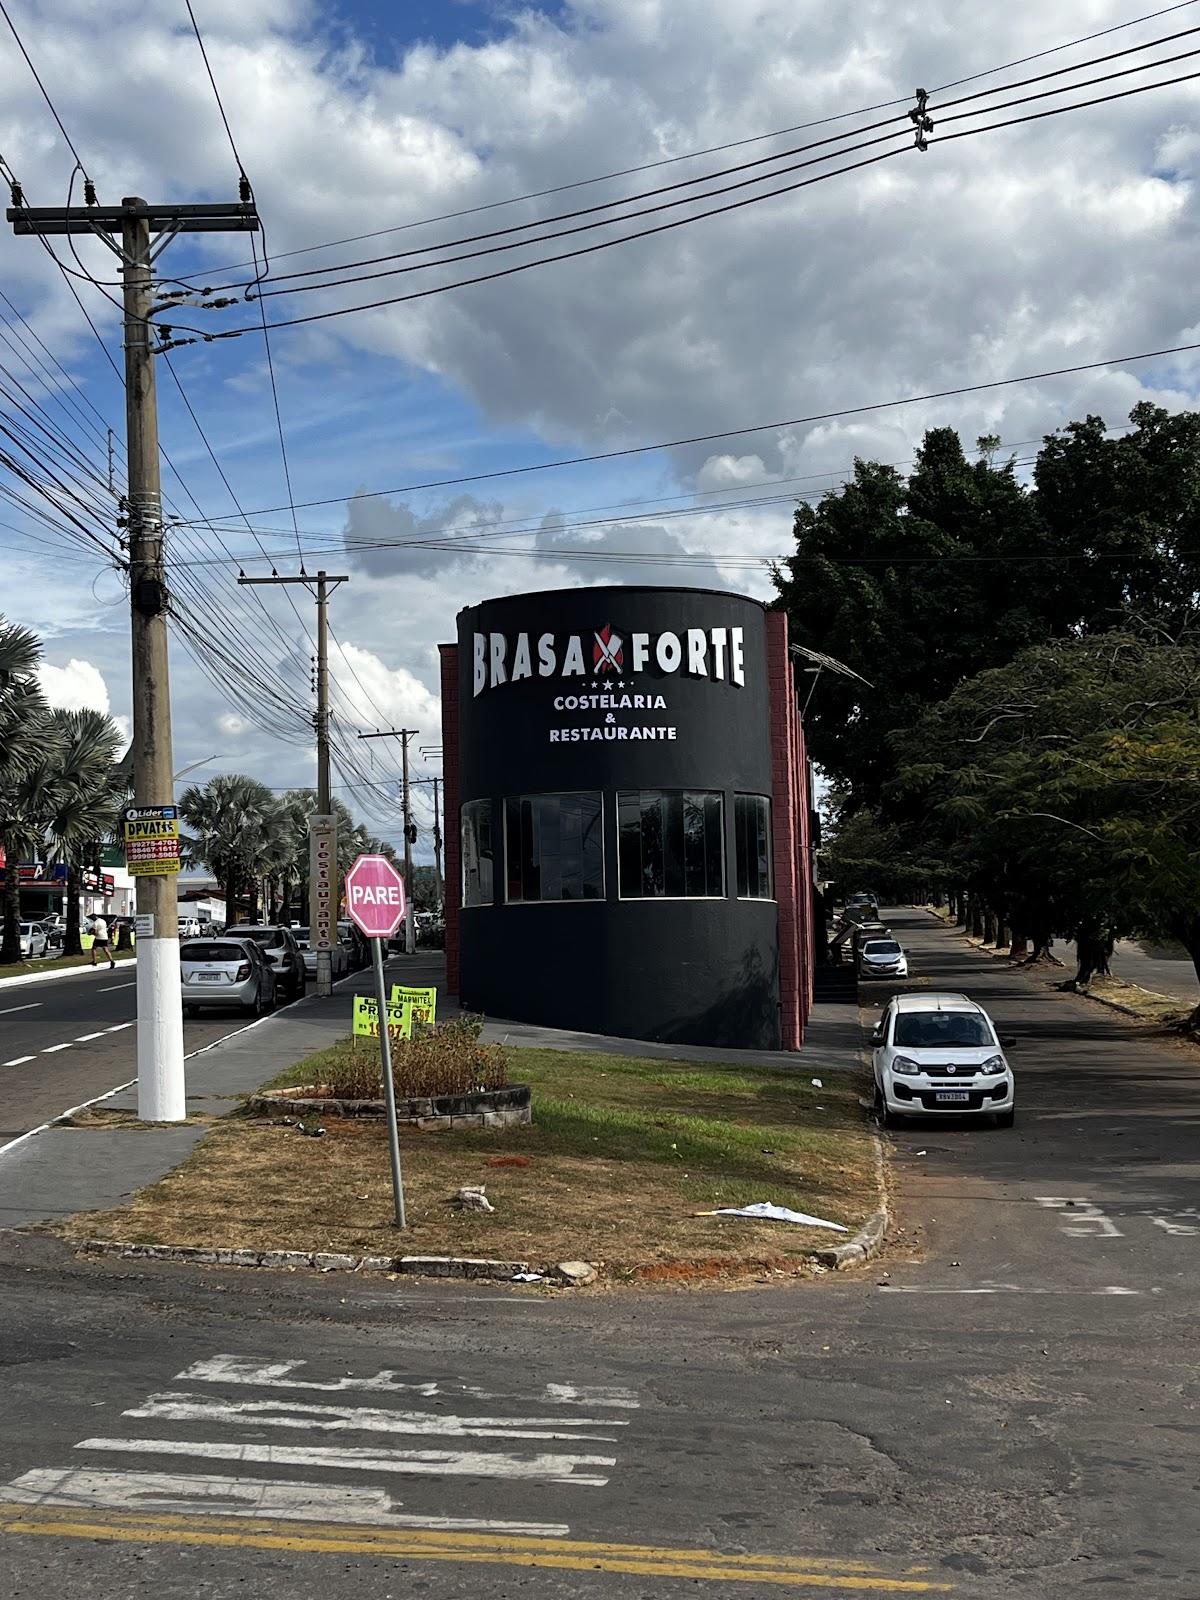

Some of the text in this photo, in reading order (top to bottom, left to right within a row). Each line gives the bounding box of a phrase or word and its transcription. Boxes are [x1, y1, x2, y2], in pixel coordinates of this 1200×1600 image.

[473, 627, 745, 698] BRASA FORTE
[553, 694, 667, 710] COSTELARIA
[605, 713, 616, 724] &
[549, 727, 677, 742] RESTAURANTE
[128, 822, 160, 836] DPVAT
[318, 842, 329, 948] restaurante
[352, 885, 400, 905] PARE
